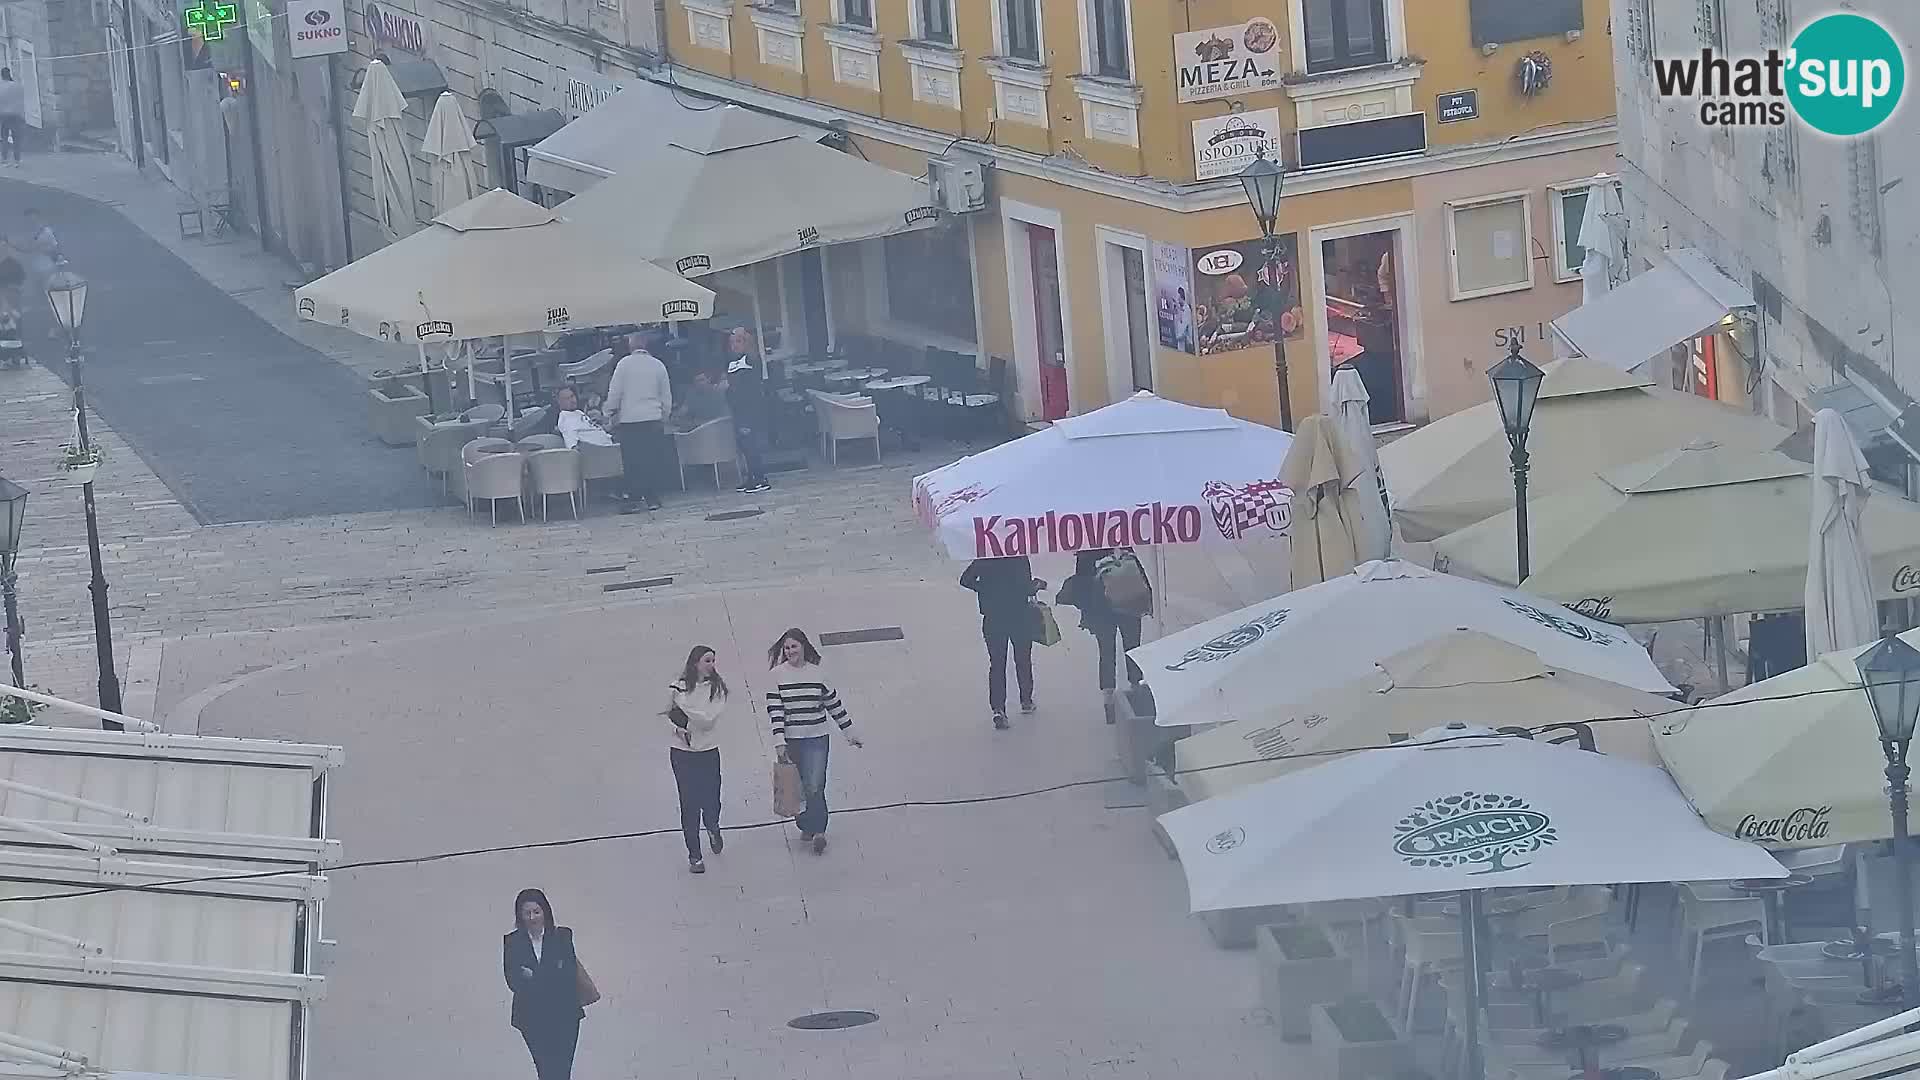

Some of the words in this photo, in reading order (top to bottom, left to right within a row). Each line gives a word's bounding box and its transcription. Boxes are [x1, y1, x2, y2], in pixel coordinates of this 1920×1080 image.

[297, 27, 342, 41] SUKNO
[383, 11, 423, 51] SUKNO
[1180, 58, 1259, 88] MEZA
[1190, 85, 1222, 96] PIZZERIA
[1230, 79, 1250, 90] GRILL
[1199, 143, 1245, 162] ISPOD
[547, 307, 568, 321] ŽUJA
[972, 501, 1201, 558] Karlovačko
[1432, 815, 1532, 847] RAUCH
[1735, 805, 1832, 842] Coca-Cola
